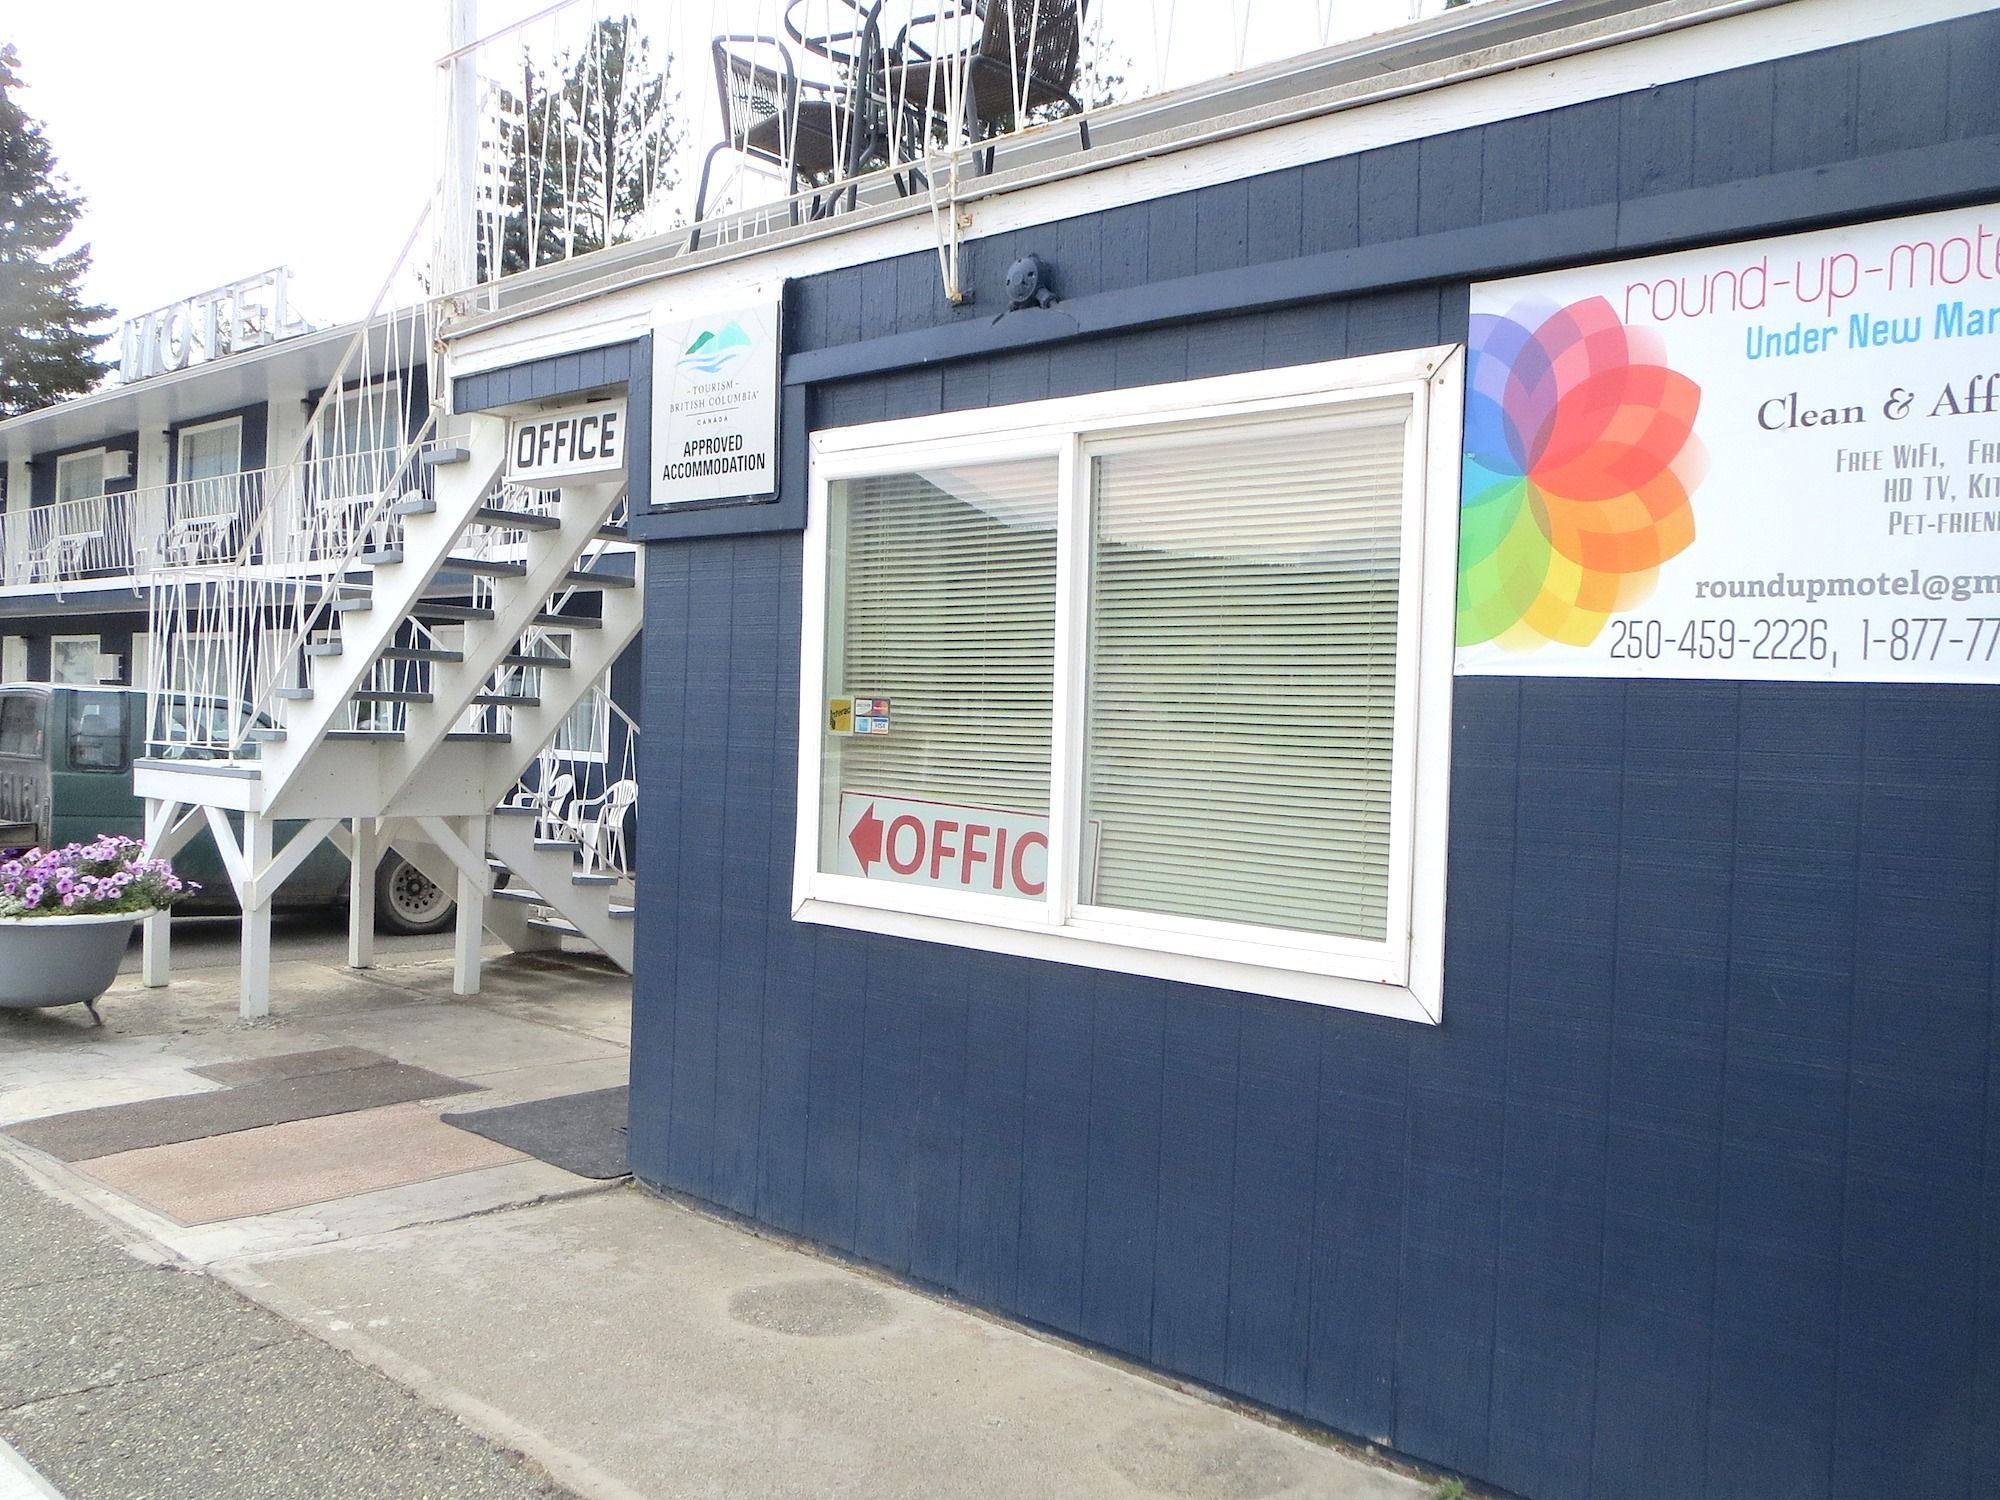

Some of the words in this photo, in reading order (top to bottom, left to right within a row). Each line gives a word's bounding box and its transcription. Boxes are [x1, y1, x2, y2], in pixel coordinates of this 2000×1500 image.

[1625, 223, 2000, 325] round-up-mot
[119, 265, 317, 383] MOTEL
[1746, 322, 1838, 360] Under
[1848, 312, 1921, 349] New
[670, 399, 705, 413] BRITISH
[708, 391, 759, 407] COLUMBIA
[693, 380, 734, 395] TOURISM
[1757, 391, 1867, 431] Clean
[1883, 388, 1915, 420] &
[1926, 373, 2000, 417] Aff
[696, 415, 729, 426] CANADA
[517, 413, 617, 468] OFFICE
[683, 434, 743, 457] APPROVED
[662, 453, 765, 480] ACCOMMODATION
[1884, 477, 1912, 503] HD
[1923, 475, 1956, 503] TV,
[1610, 618, 1837, 669] 250-459-2226,
[1862, 617, 2000, 661] 1-877-77
